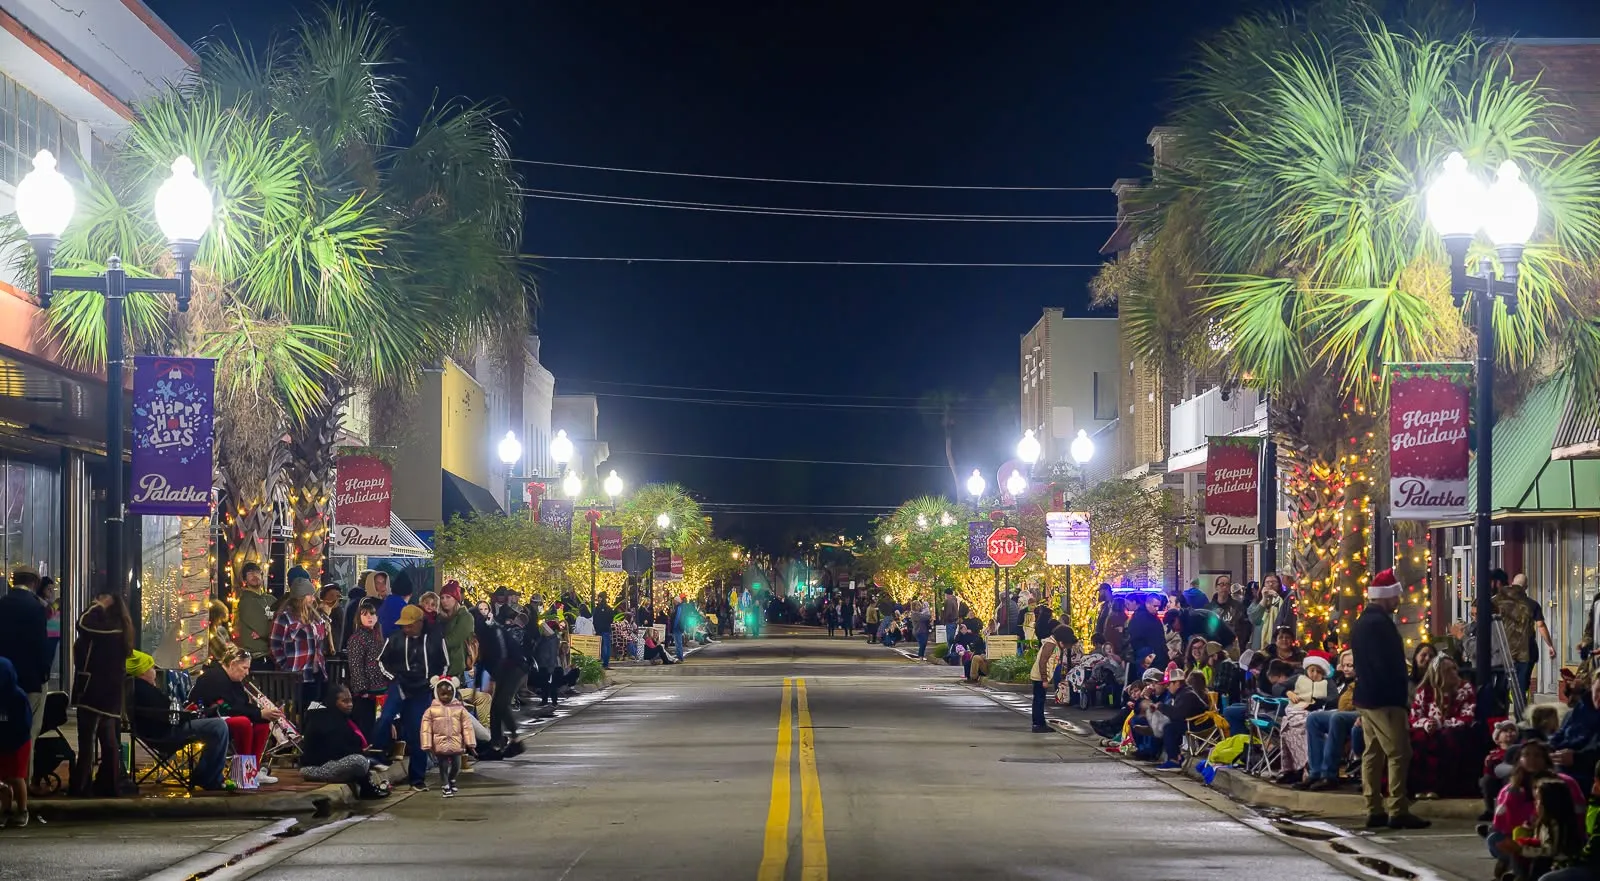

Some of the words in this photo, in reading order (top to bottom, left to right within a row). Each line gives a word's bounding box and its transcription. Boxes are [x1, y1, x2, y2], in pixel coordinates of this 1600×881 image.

[1402, 408, 1461, 429] Happy
[1391, 427, 1467, 452] Holidays
[344, 477, 385, 492] Happy
[1214, 467, 1254, 482] Happy
[133, 473, 208, 503] Palatka
[1206, 480, 1257, 497] Holidays
[1394, 480, 1467, 507] Palatka
[337, 490, 390, 507] Holidays
[337, 526, 388, 546] Palatka
[1208, 516, 1256, 536] Palatka
[990, 539, 1023, 555] STOP
